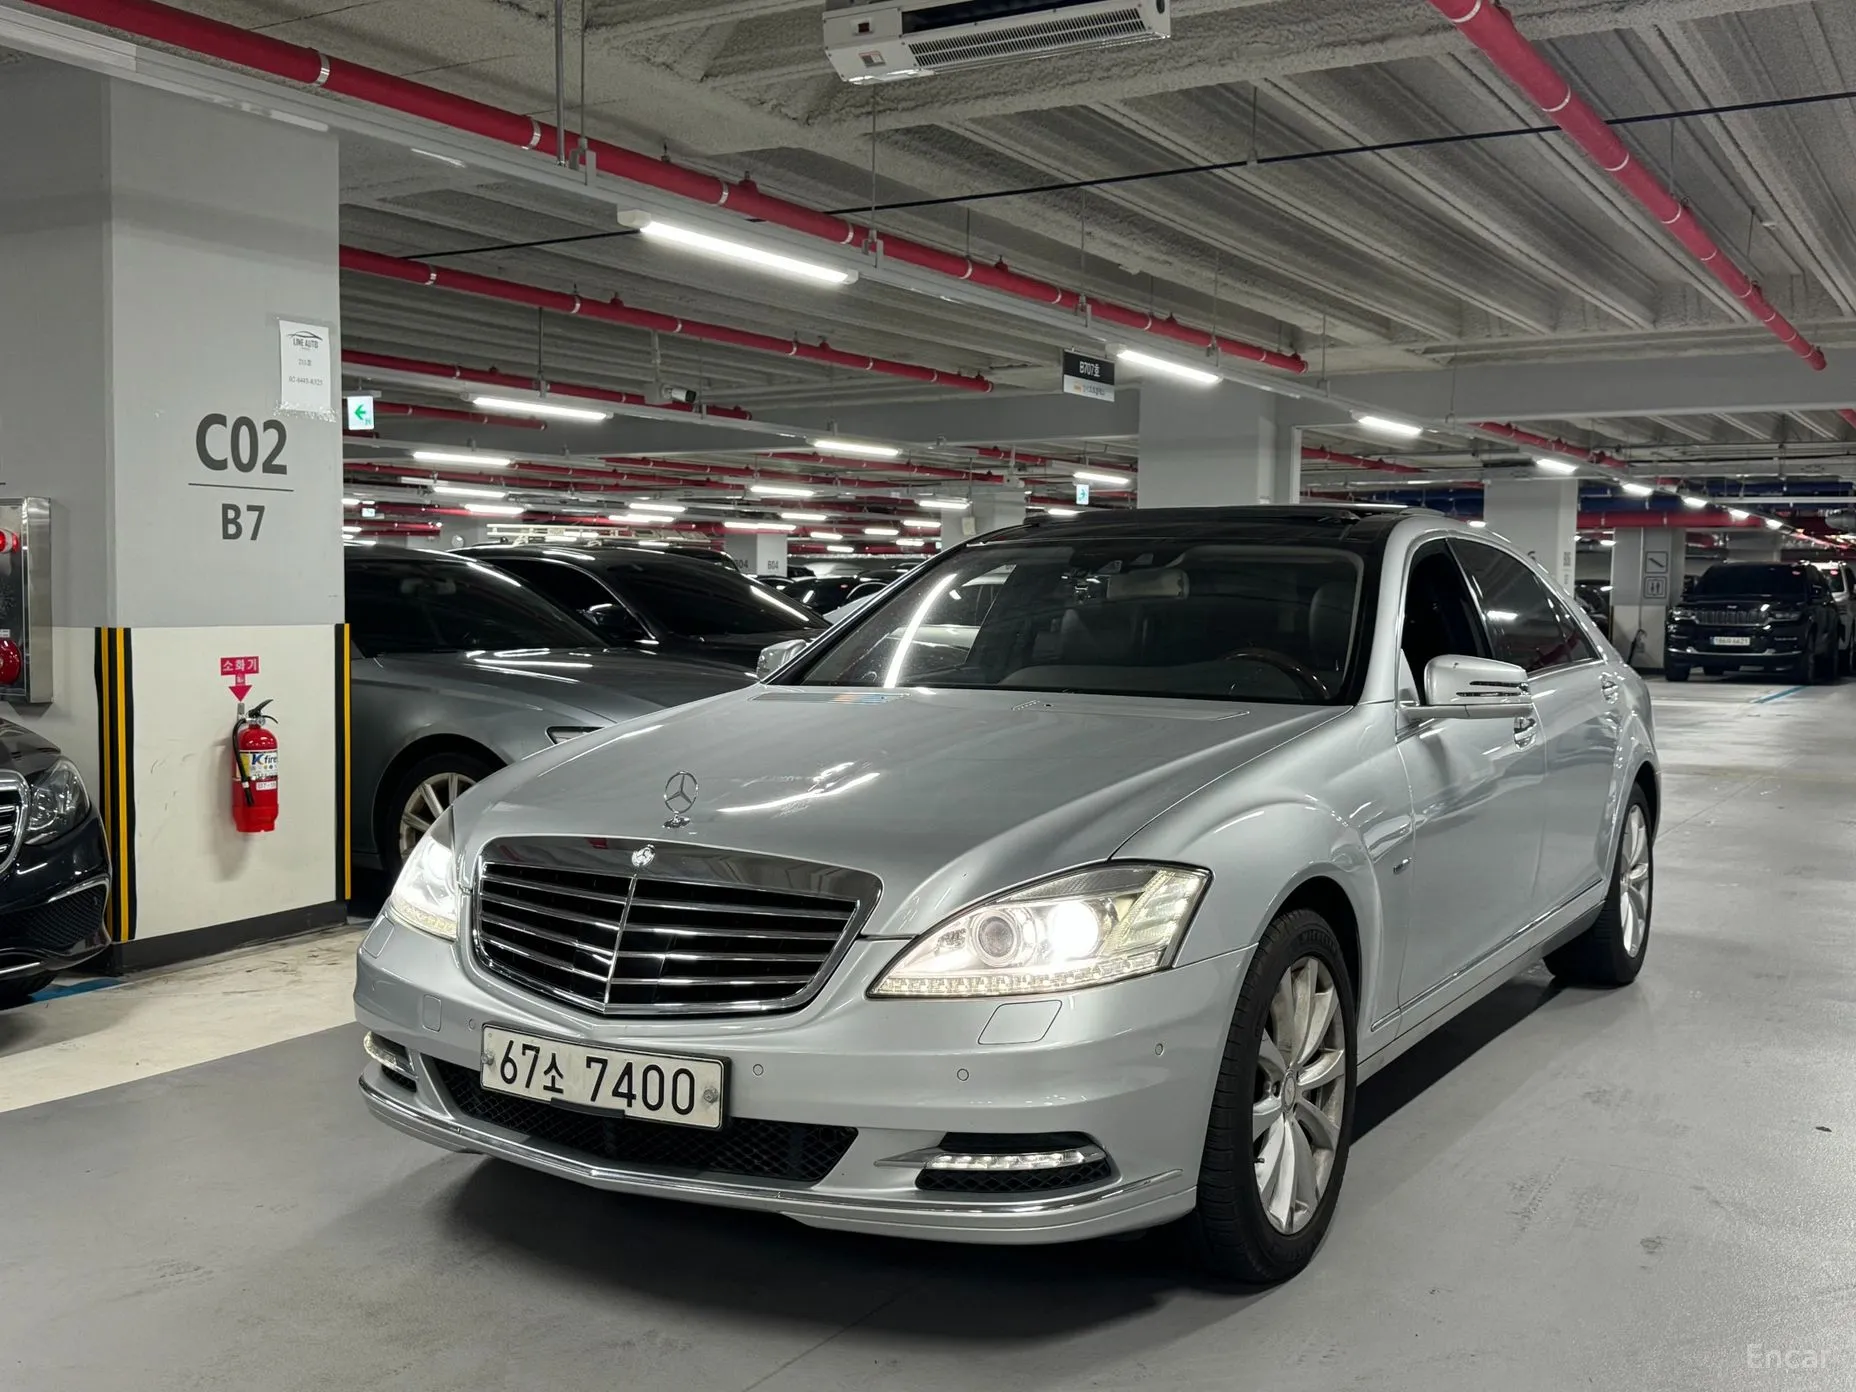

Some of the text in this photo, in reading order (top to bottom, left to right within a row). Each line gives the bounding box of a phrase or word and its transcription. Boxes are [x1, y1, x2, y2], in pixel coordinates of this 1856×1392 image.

[195, 413, 288, 475] C02
[221, 503, 266, 541] B7
[222, 658, 257, 671] 소화기
[500, 1040, 695, 1116] 67소 7400
